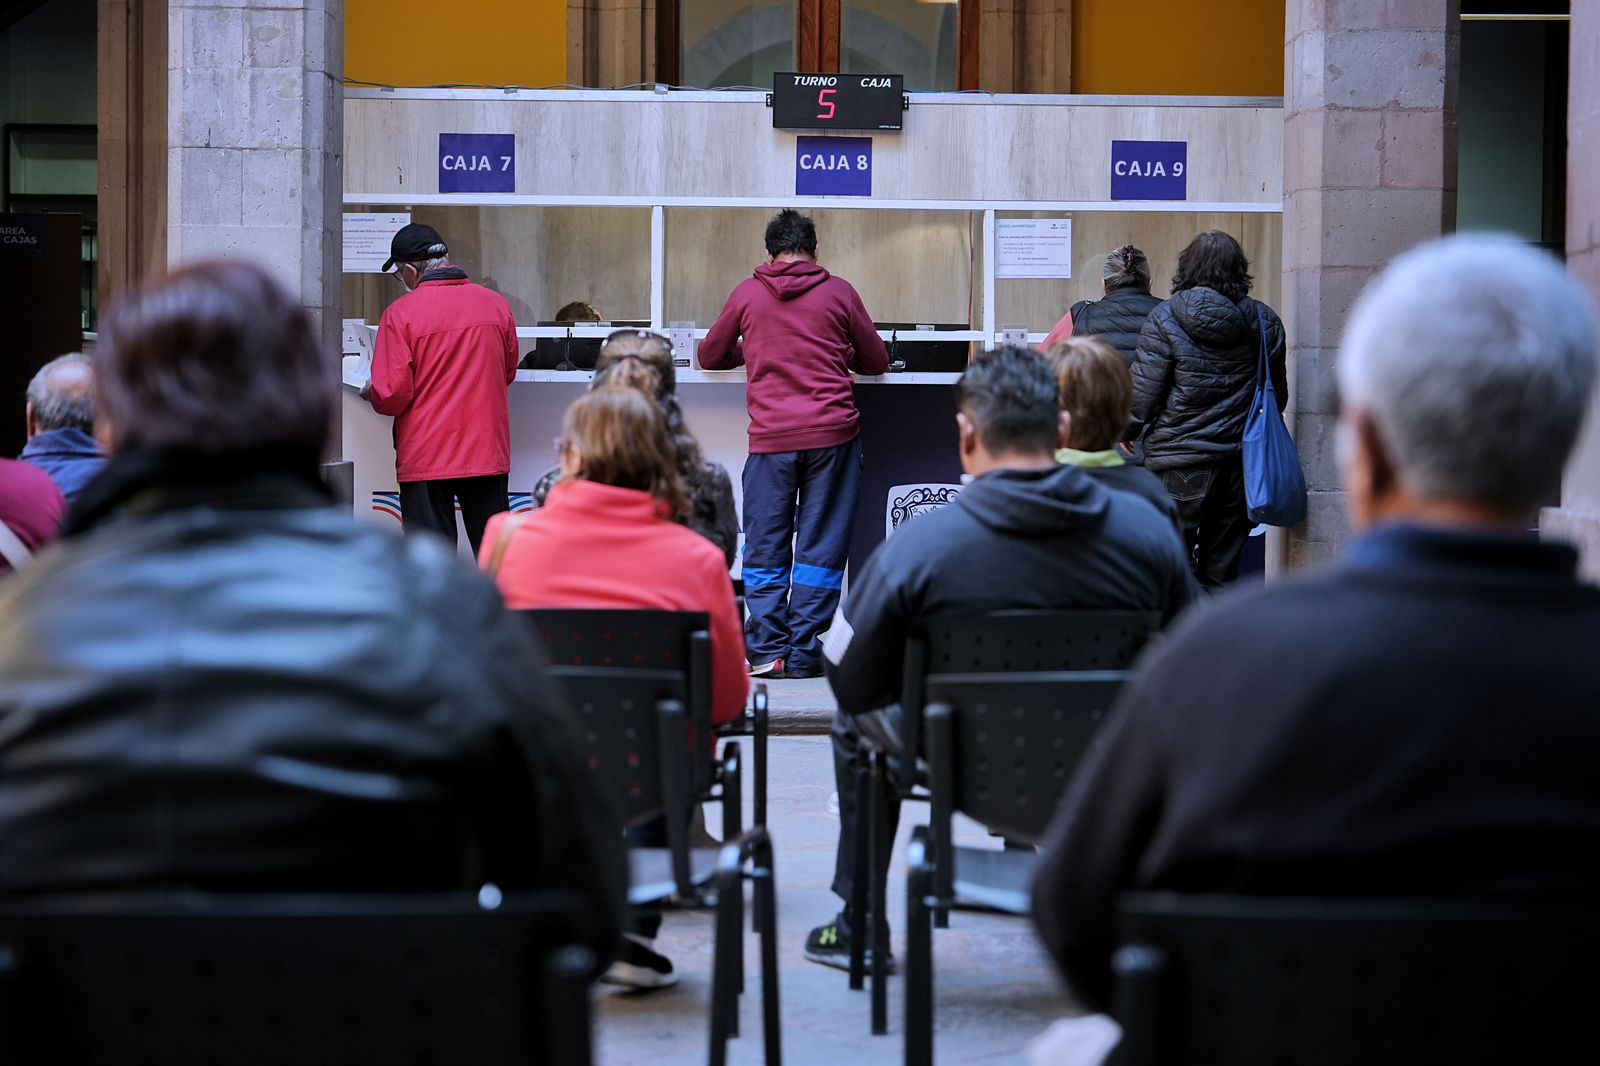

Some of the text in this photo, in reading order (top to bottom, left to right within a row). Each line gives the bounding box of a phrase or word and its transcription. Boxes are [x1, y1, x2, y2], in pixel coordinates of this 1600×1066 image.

[793, 76, 891, 88] TURNO CAJA
[816, 89, 837, 119] 5
[442, 155, 511, 171] CAJA 7
[799, 154, 868, 171] CAJA 8
[1114, 160, 1184, 177] CAJA 9
[3, 235, 37, 244] CAJAS
